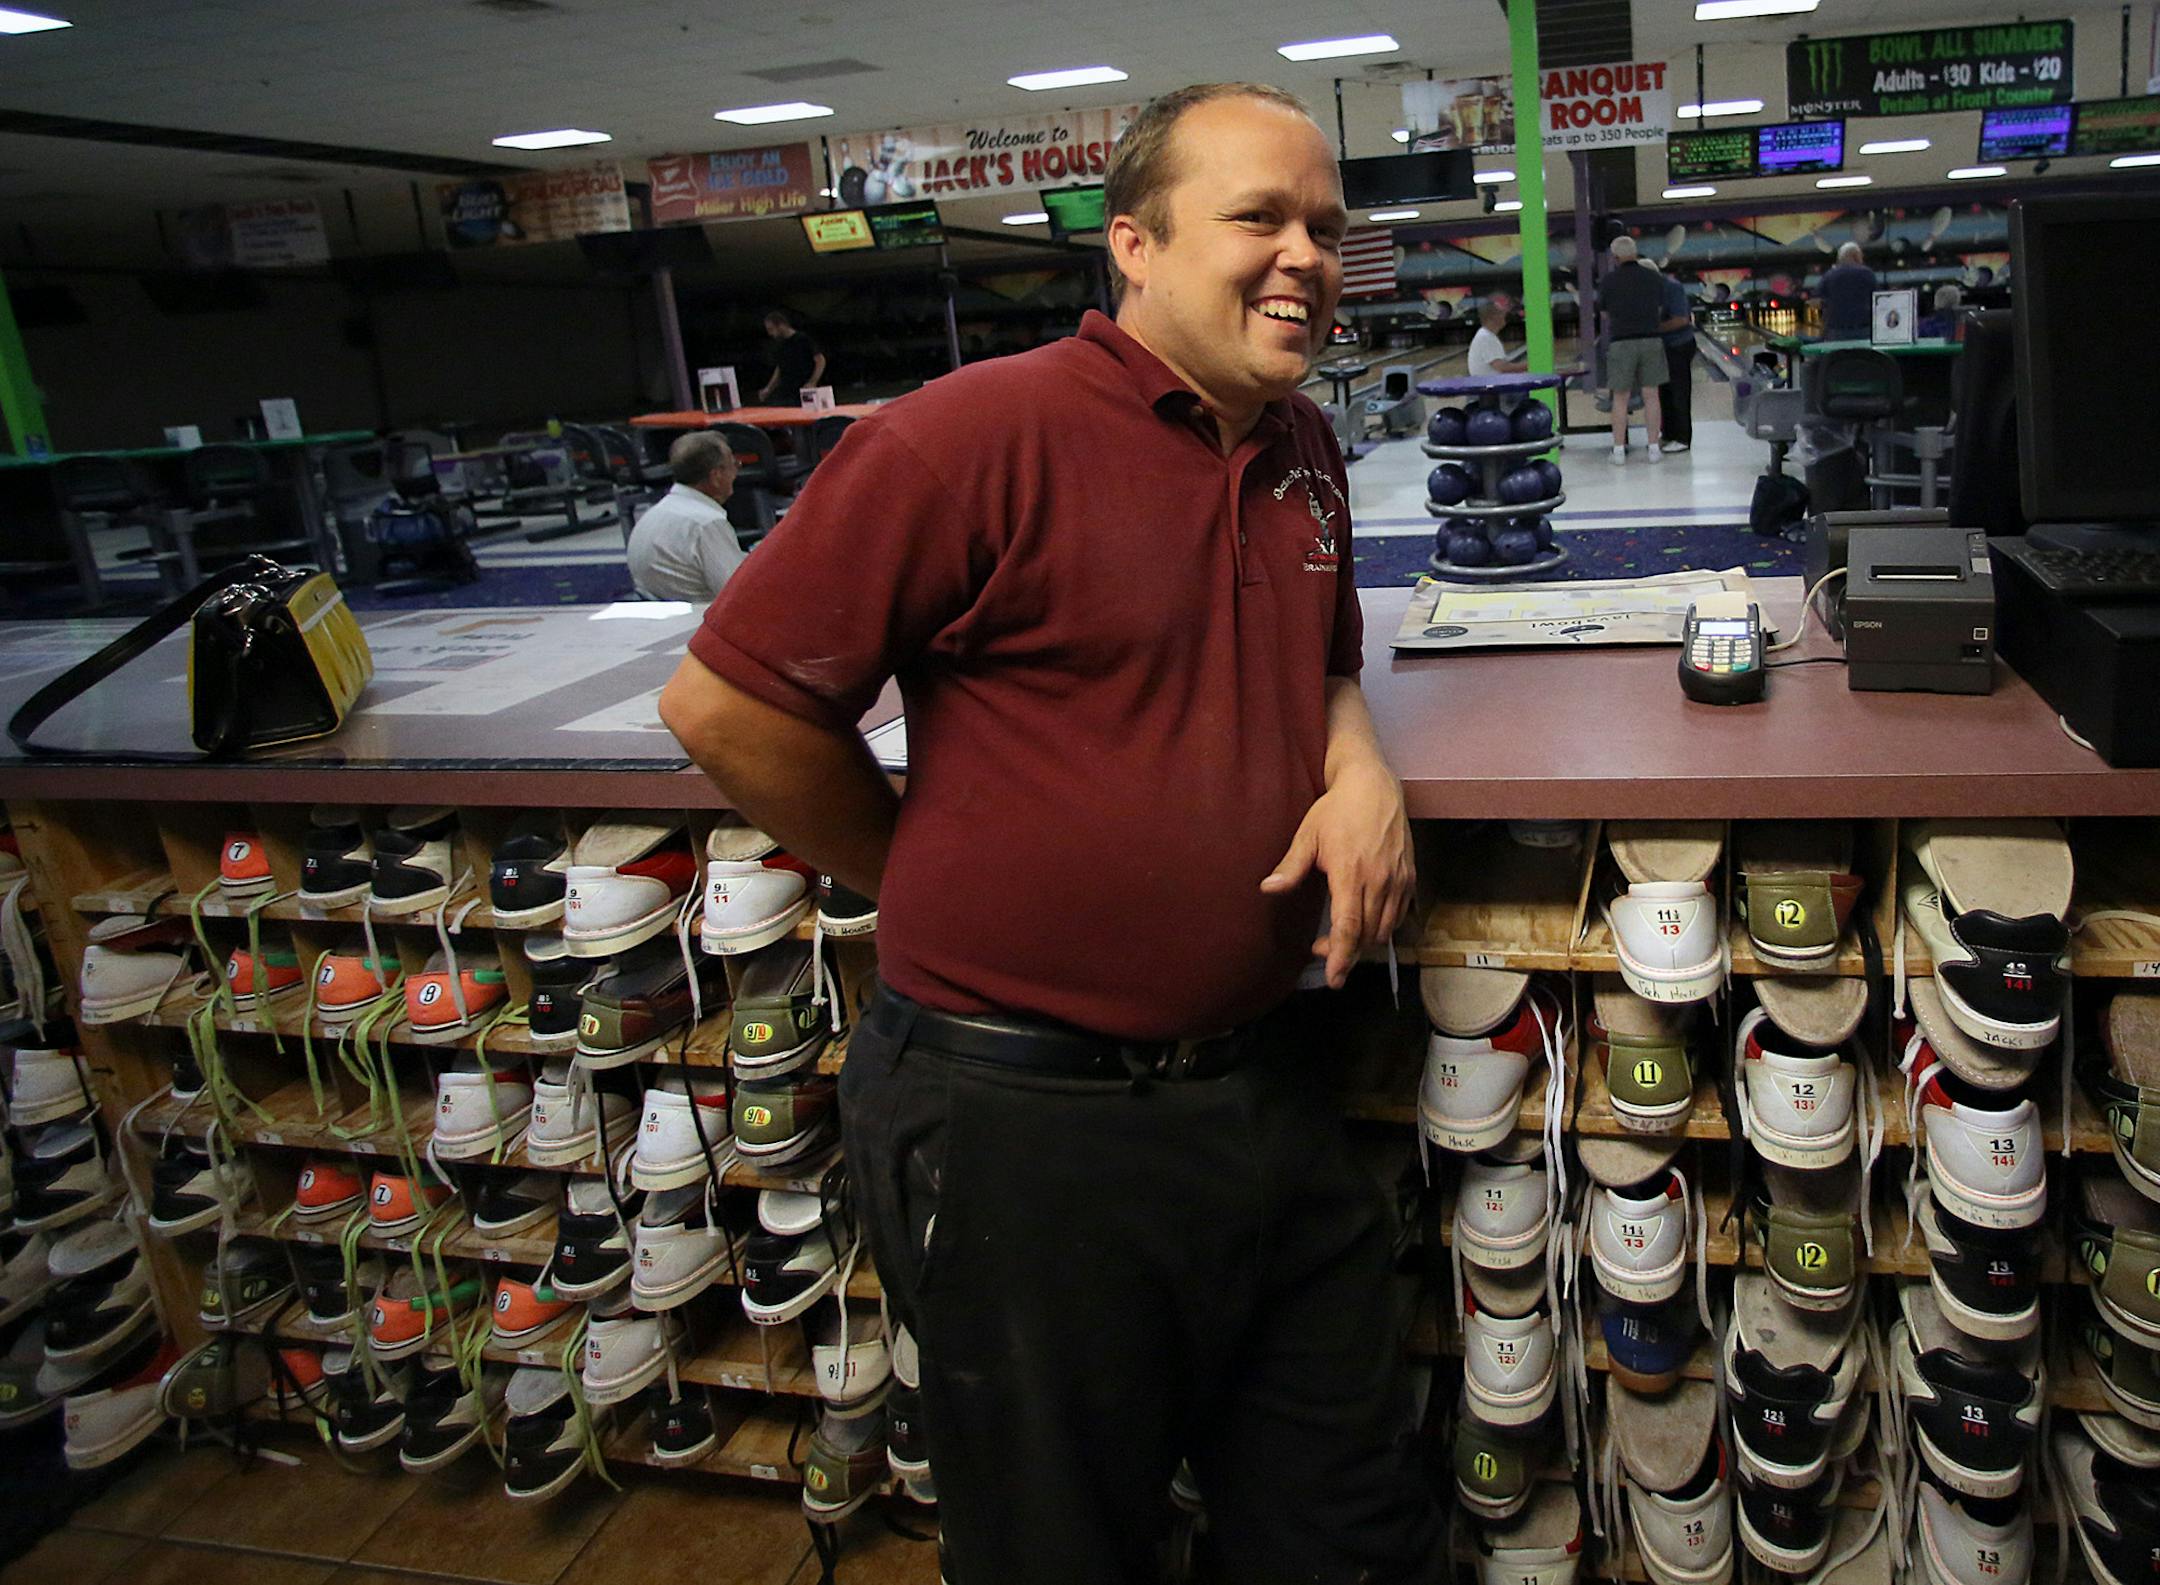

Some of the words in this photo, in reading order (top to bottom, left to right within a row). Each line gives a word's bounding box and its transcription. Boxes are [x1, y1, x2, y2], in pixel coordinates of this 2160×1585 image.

[1870, 37, 1925, 63] BOWL
[1932, 32, 1966, 57] ALL
[1974, 26, 2064, 55] SUMMER
[1873, 67, 1925, 93] Adults
[1943, 64, 1971, 87] $30
[1980, 60, 2015, 84] Kids
[2033, 57, 2061, 80] $20
[1952, 90, 1993, 107] Front
[1996, 86, 2054, 104] Counter
[1551, 97, 1644, 131] ROOM
[1790, 100, 1862, 115] MONSTER
[966, 128, 1045, 150] Welcome
[1052, 126, 1069, 142] to
[1566, 134, 1581, 145] up
[1584, 130, 1597, 142] to
[1600, 128, 1622, 141] 350
[1625, 126, 1665, 141] People
[922, 152, 1014, 194] JACK'S
[740, 195, 774, 216] High
[779, 192, 807, 208] Life
[1853, 620, 1883, 629] EPSON
[234, 844, 245, 858] 7
[570, 889, 578, 898] 9
[714, 895, 728, 904] 11
[1779, 902, 1800, 925] 12
[1660, 925, 1680, 935] 13
[1477, 955, 1488, 965] 11
[228, 963, 236, 977] 7
[425, 985, 437, 1003] 8
[1441, 1063, 1456, 1074] 11
[1639, 1063, 1656, 1083] 11
[1792, 1084, 1814, 1094] 12
[535, 1115, 546, 1124] 10
[650, 1113, 657, 1121] 9
[1990, 1139, 2015, 1151] 13
[304, 1173, 311, 1187] 7
[1485, 1189, 1502, 1199] 11
[1624, 1238, 1644, 1248] 13
[1802, 1246, 1821, 1267] 12
[1990, 1260, 2009, 1272] 13
[499, 1292, 509, 1310] 8
[1498, 1343, 1514, 1352] 11
[1964, 1405, 1984, 1420] 13
[1478, 1455, 1492, 1478] 11
[1683, 1520, 1704, 1534] 12
[1978, 1550, 1999, 1562] 13
